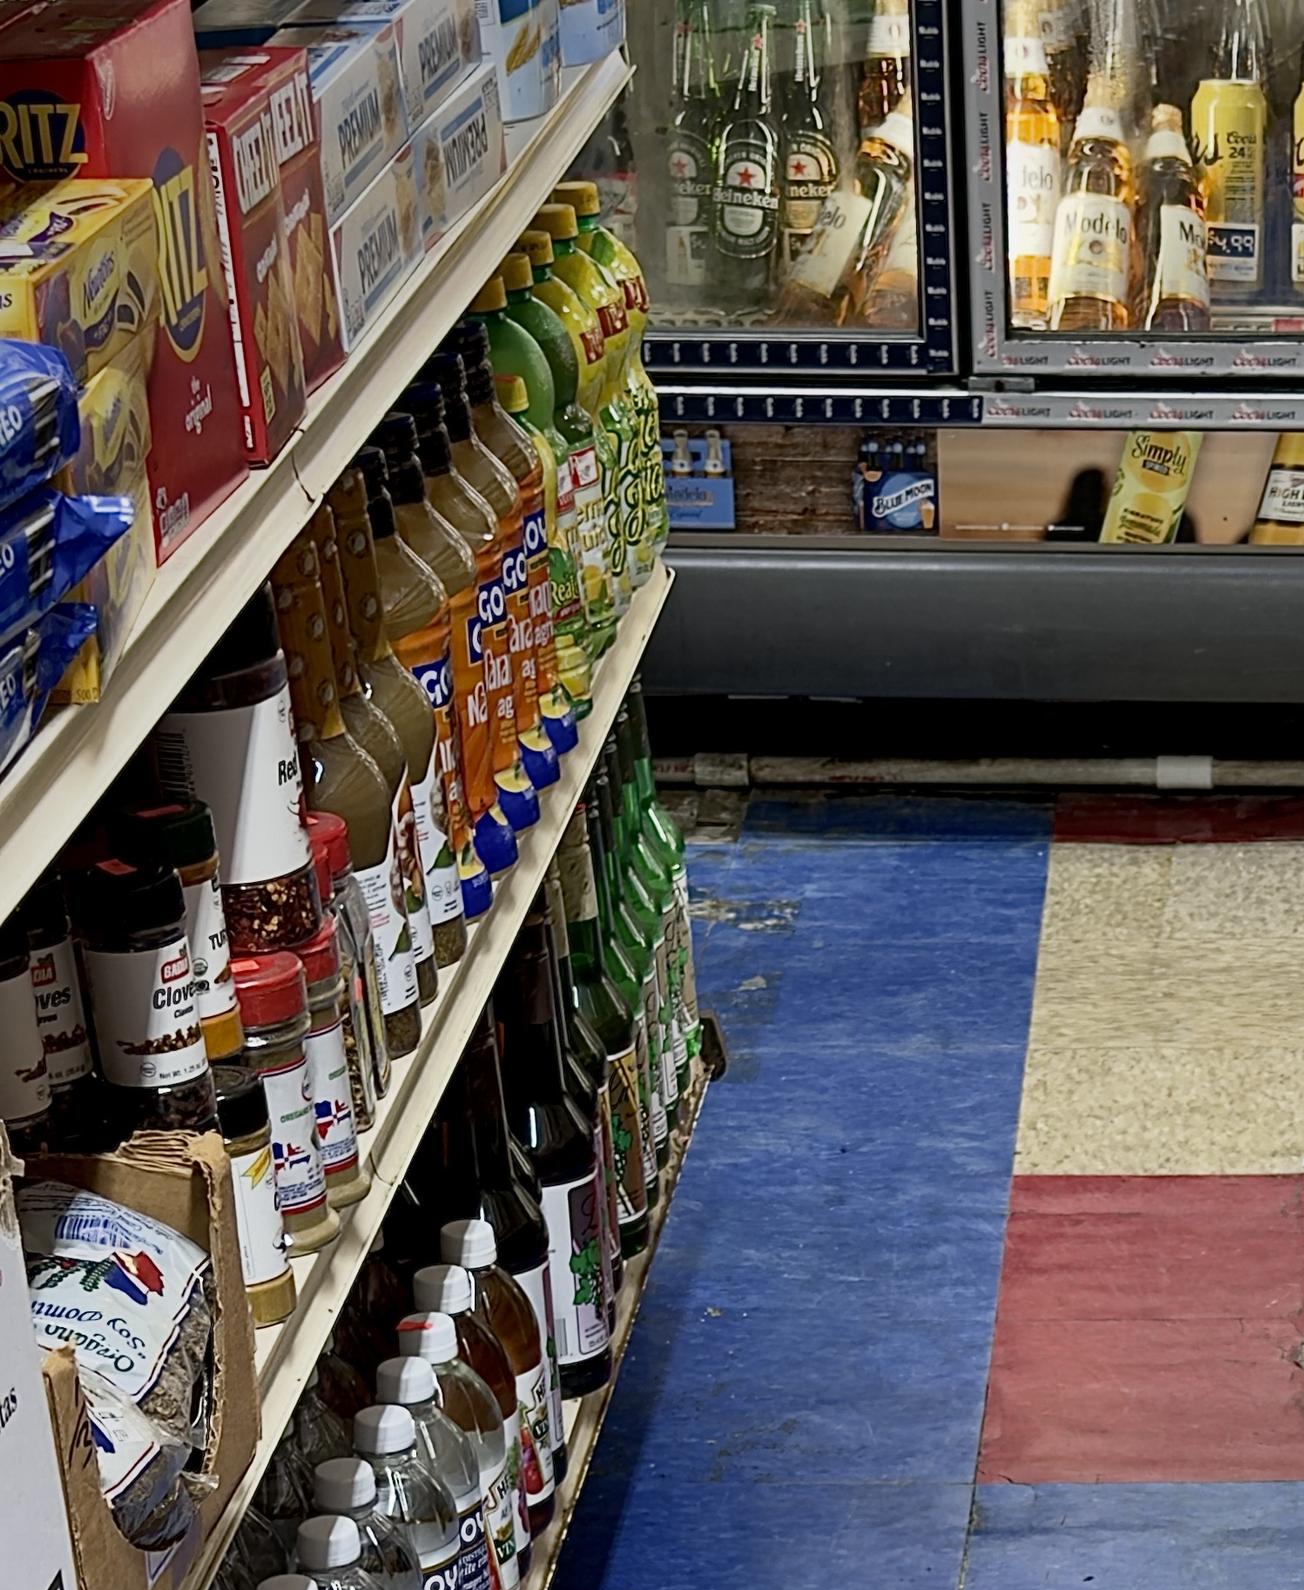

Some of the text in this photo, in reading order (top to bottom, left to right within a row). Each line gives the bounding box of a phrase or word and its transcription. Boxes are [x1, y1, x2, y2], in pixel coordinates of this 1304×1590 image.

[977, 21, 987, 53] LIGHT
[337, 87, 379, 172] PREMIUM
[979, 112, 989, 143] LIGHT
[983, 202, 992, 233] LIGHT
[1064, 208, 1128, 246] Modelo
[357, 209, 397, 294] PREMIUM
[986, 289, 995, 319] LIGHT
[1184, 356, 1214, 367] LIGHT
[1105, 408, 1133, 419] LIGHT
[1132, 433, 1187, 475] Simply
[1268, 486, 1302, 501] HIGH
[478, 587, 504, 625] GO
